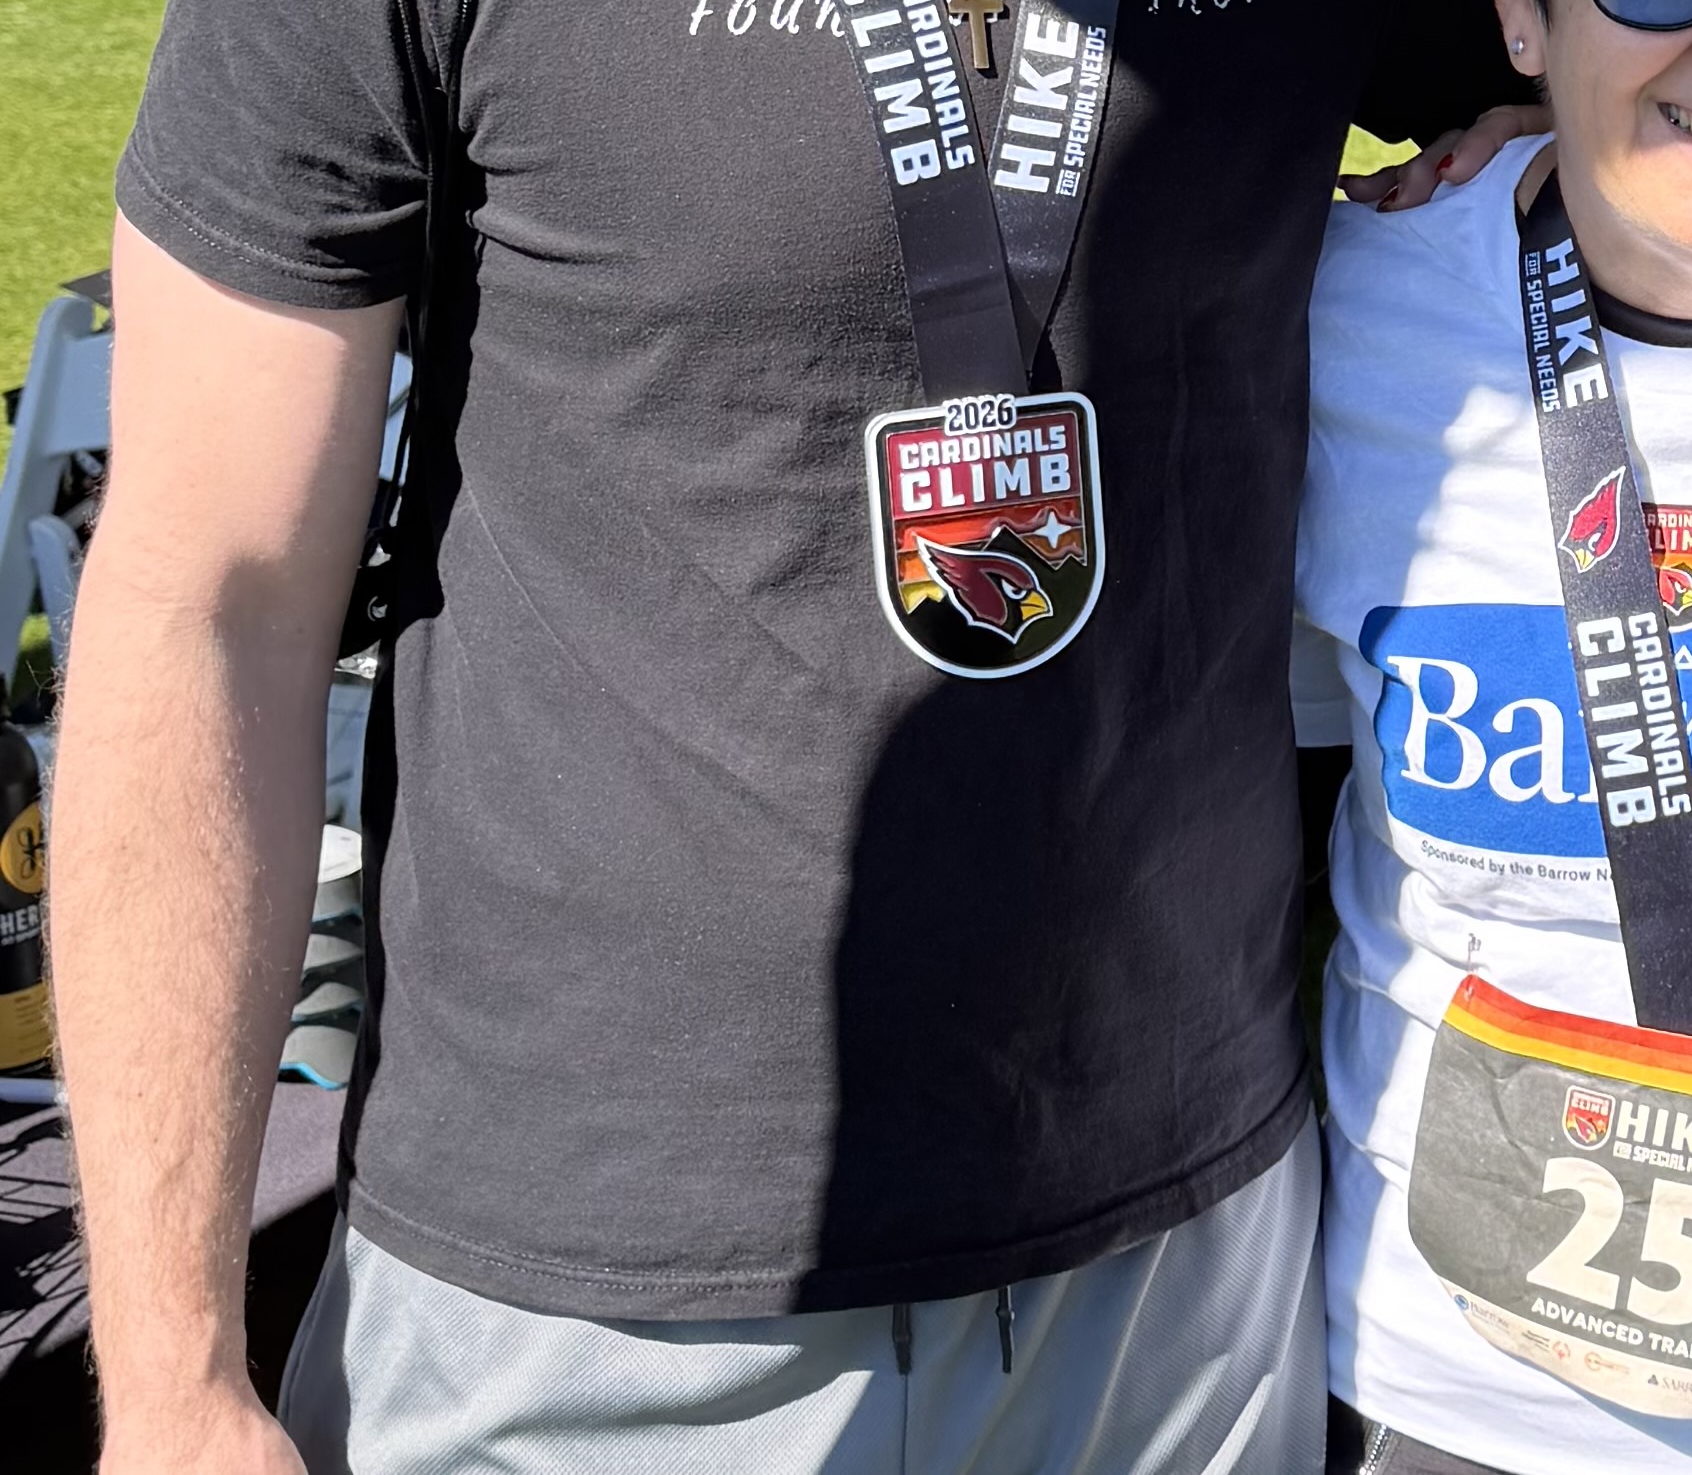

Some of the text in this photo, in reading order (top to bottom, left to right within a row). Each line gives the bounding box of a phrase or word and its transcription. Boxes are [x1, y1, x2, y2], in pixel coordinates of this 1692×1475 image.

[1079, 25, 1107, 88] NEEDS
[994, 12, 1080, 193] HIKE
[1063, 90, 1097, 168] SPECIAL
[1527, 279, 1551, 353] SPECIAL
[1545, 237, 1609, 408] HIKE
[1536, 353, 1561, 413] NEEDS
[947, 398, 1013, 431] 2026
[900, 425, 1066, 469] CARDINALS
[901, 453, 1071, 512] CLIMB
[1576, 616, 1657, 827] CLIMB
[1628, 612, 1692, 816] CARDINALS
[1421, 840, 1485, 871] Sponsored
[1489, 862, 1505, 875] by
[1510, 862, 1533, 875] the
[1538, 865, 1590, 881] Barrow
[1632, 1145, 1685, 1172] SPECIAL
[1531, 1297, 1644, 1346] ADVANCED
